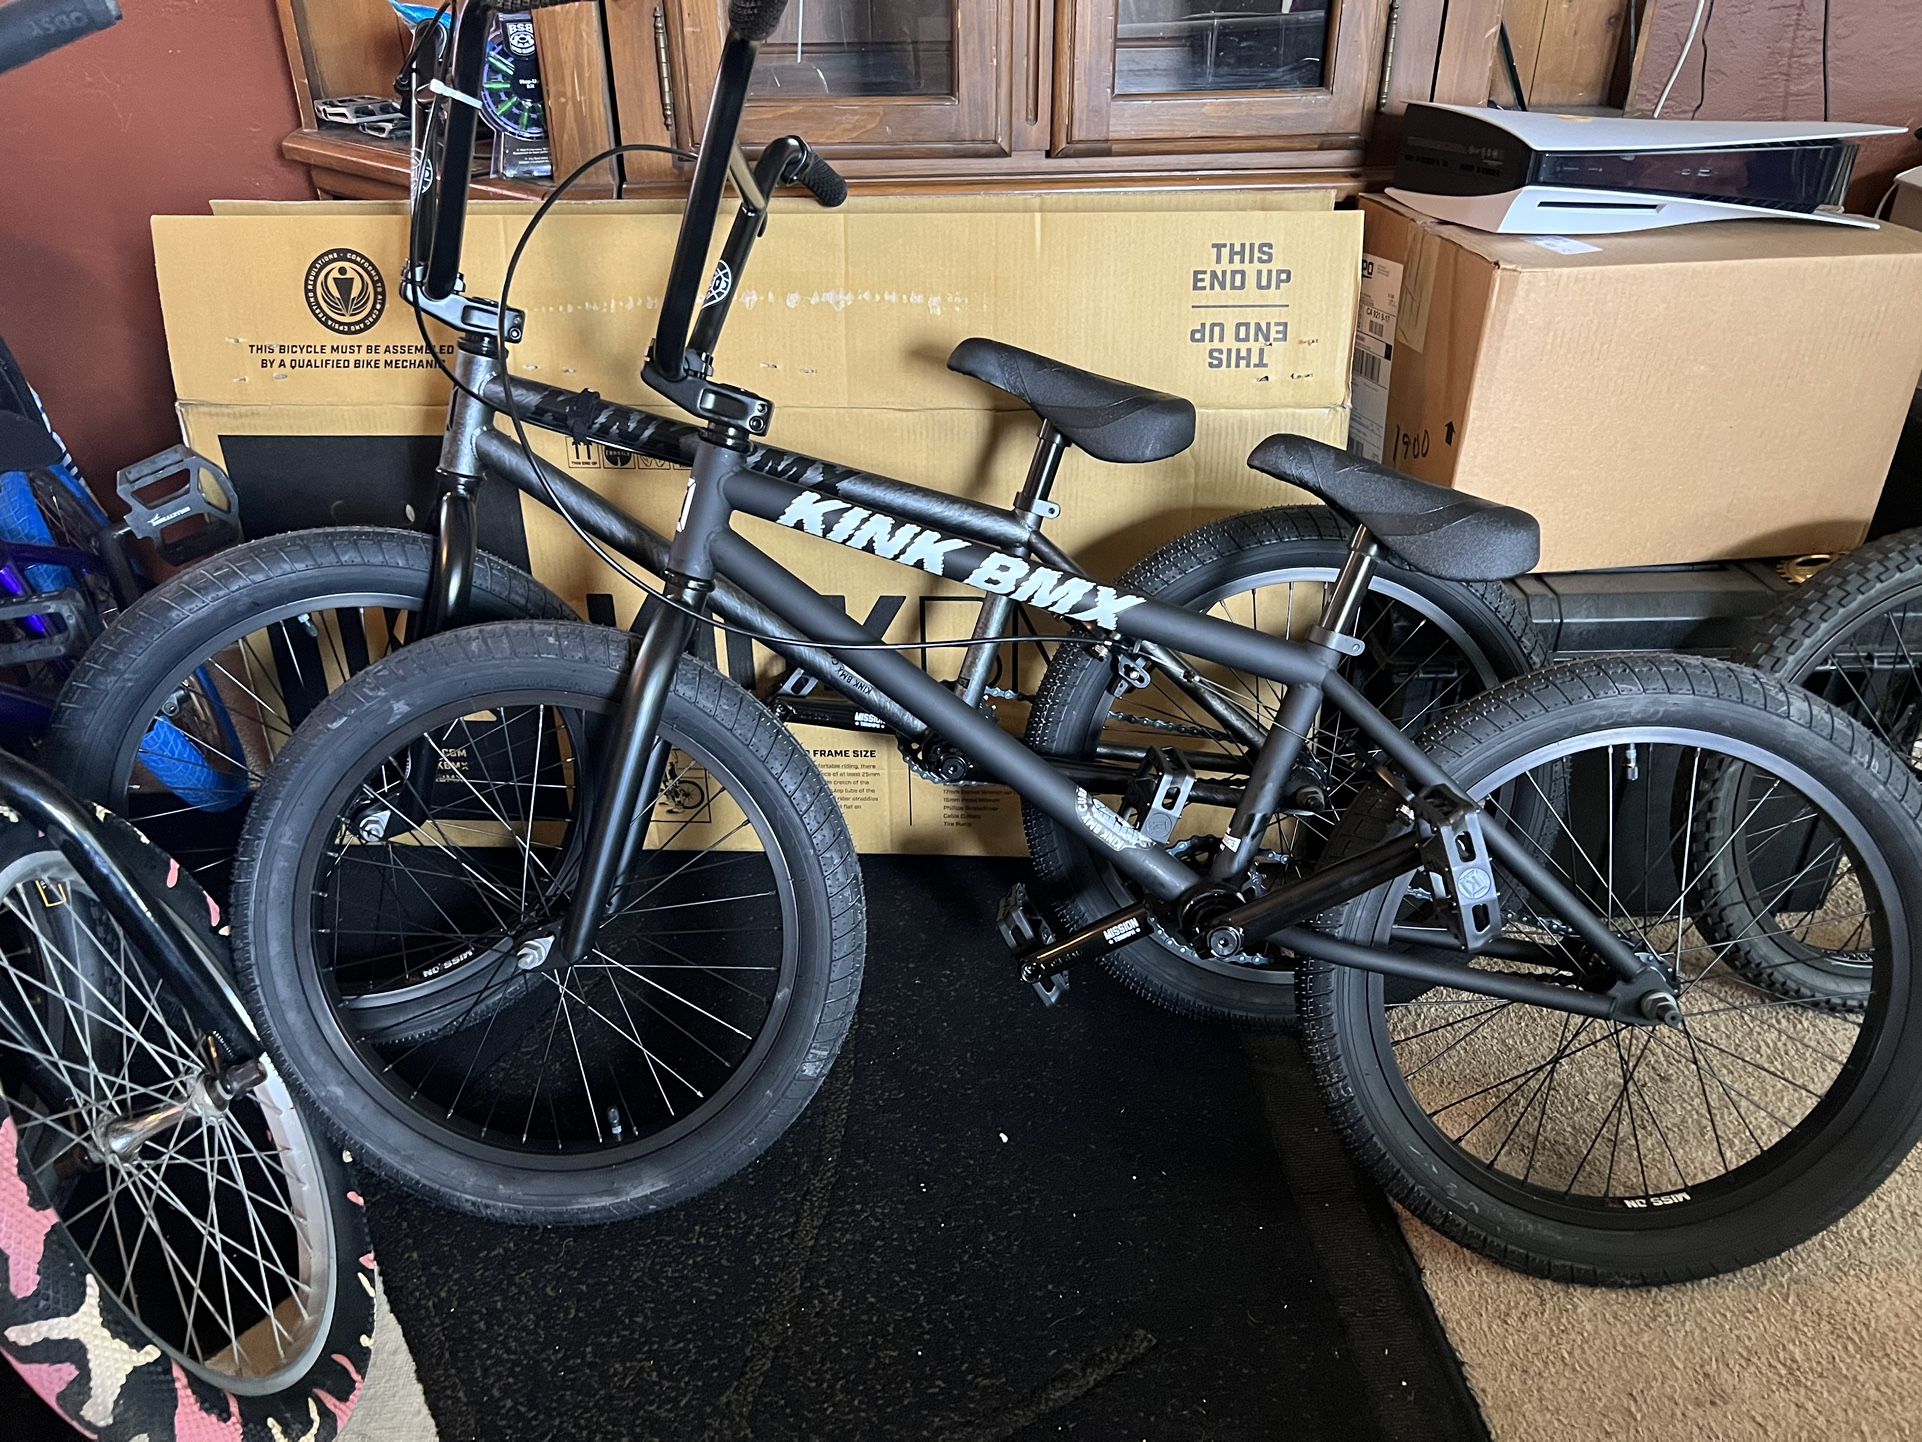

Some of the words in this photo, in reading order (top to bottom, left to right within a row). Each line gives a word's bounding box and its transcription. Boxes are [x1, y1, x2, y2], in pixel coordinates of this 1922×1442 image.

[1211, 242, 1274, 264] THIS
[308, 253, 338, 290] REGULATIONS
[346, 253, 379, 281] CONFORMS
[1192, 270, 1246, 291] END
[1256, 269, 1292, 290] UP
[308, 292, 326, 321] TESTING
[1190, 322, 1225, 343] UP
[1234, 322, 1288, 342] END
[249, 344, 274, 354] THIS
[278, 344, 327, 354] BICYCLE
[330, 344, 362, 354] MUST
[366, 344, 381, 354] BE
[1208, 348, 1269, 368] THIS
[260, 359, 275, 369] BY
[278, 359, 286, 369] A
[290, 359, 350, 370] QUALIFIED
[354, 359, 380, 369] BIKE
[1393, 424, 1430, 464] 1900
[776, 490, 972, 576] KINK
[964, 552, 1147, 630] BMX
[838, 666, 853, 684] BMX
[853, 679, 872, 696] KINK
[854, 712, 886, 724] MISSIO
[1100, 830, 1124, 850] KINK
[1103, 917, 1139, 940] MISSION
[422, 949, 473, 978] MISSON
[1624, 1192, 1692, 1208] MISSON
